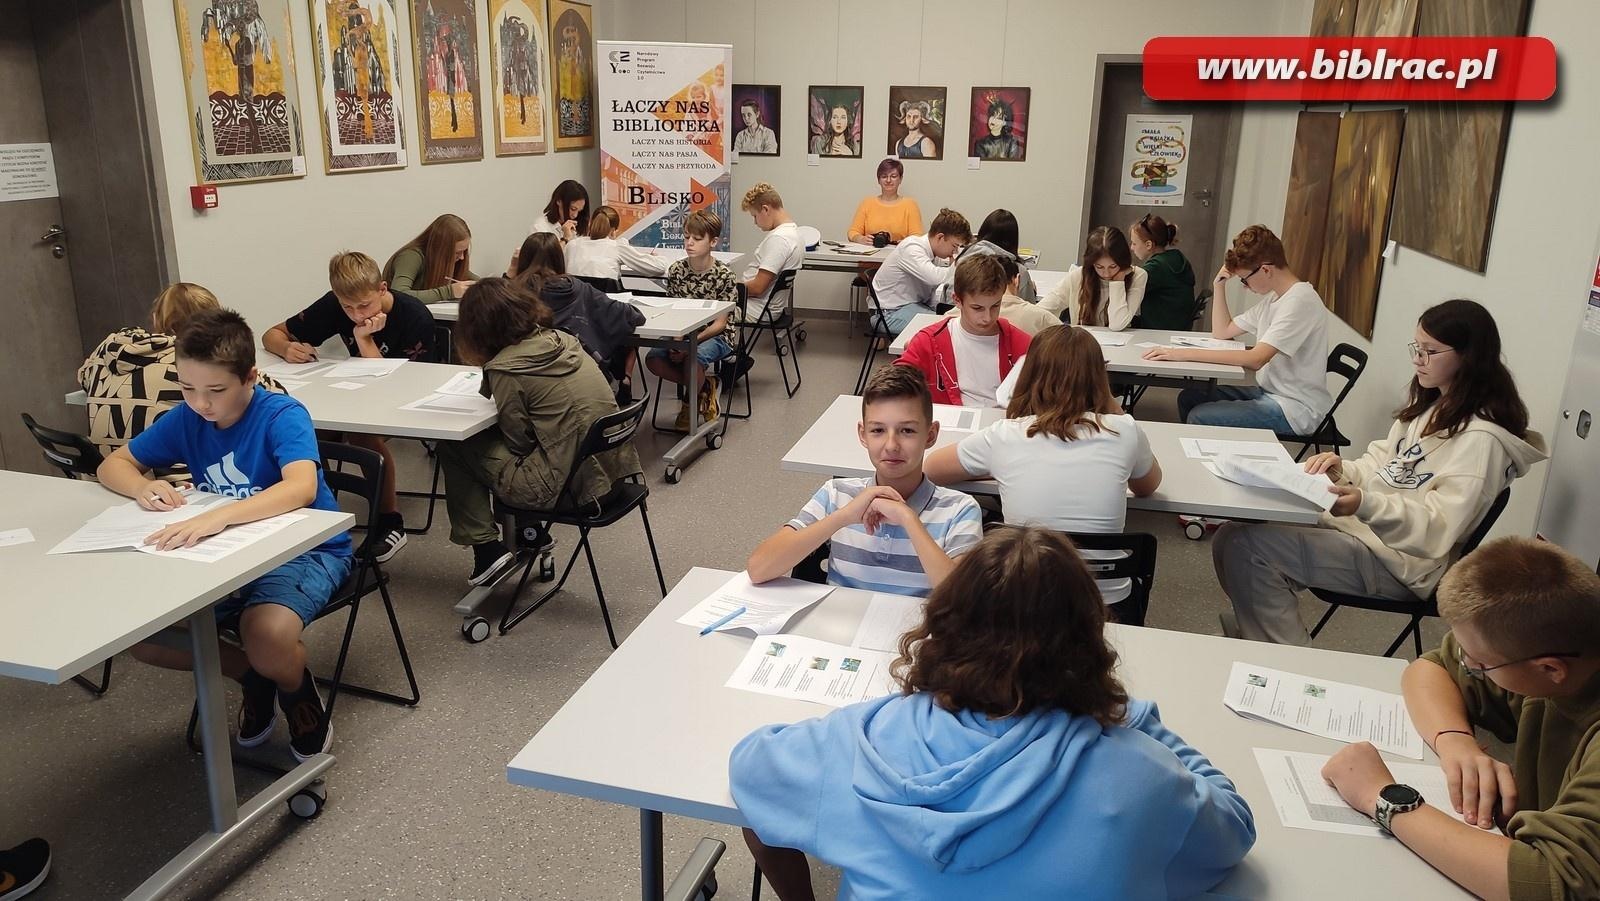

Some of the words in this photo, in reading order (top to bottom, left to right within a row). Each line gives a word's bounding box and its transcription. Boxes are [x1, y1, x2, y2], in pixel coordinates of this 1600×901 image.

[612, 99, 670, 114] ŁĄCZY
[675, 100, 710, 114] NAS
[612, 118, 721, 133] BIBLIOTEKA
[631, 139, 657, 147] ŁĄCZY
[631, 151, 657, 159] ŁĄCZY
[628, 186, 704, 205] BLISKO
